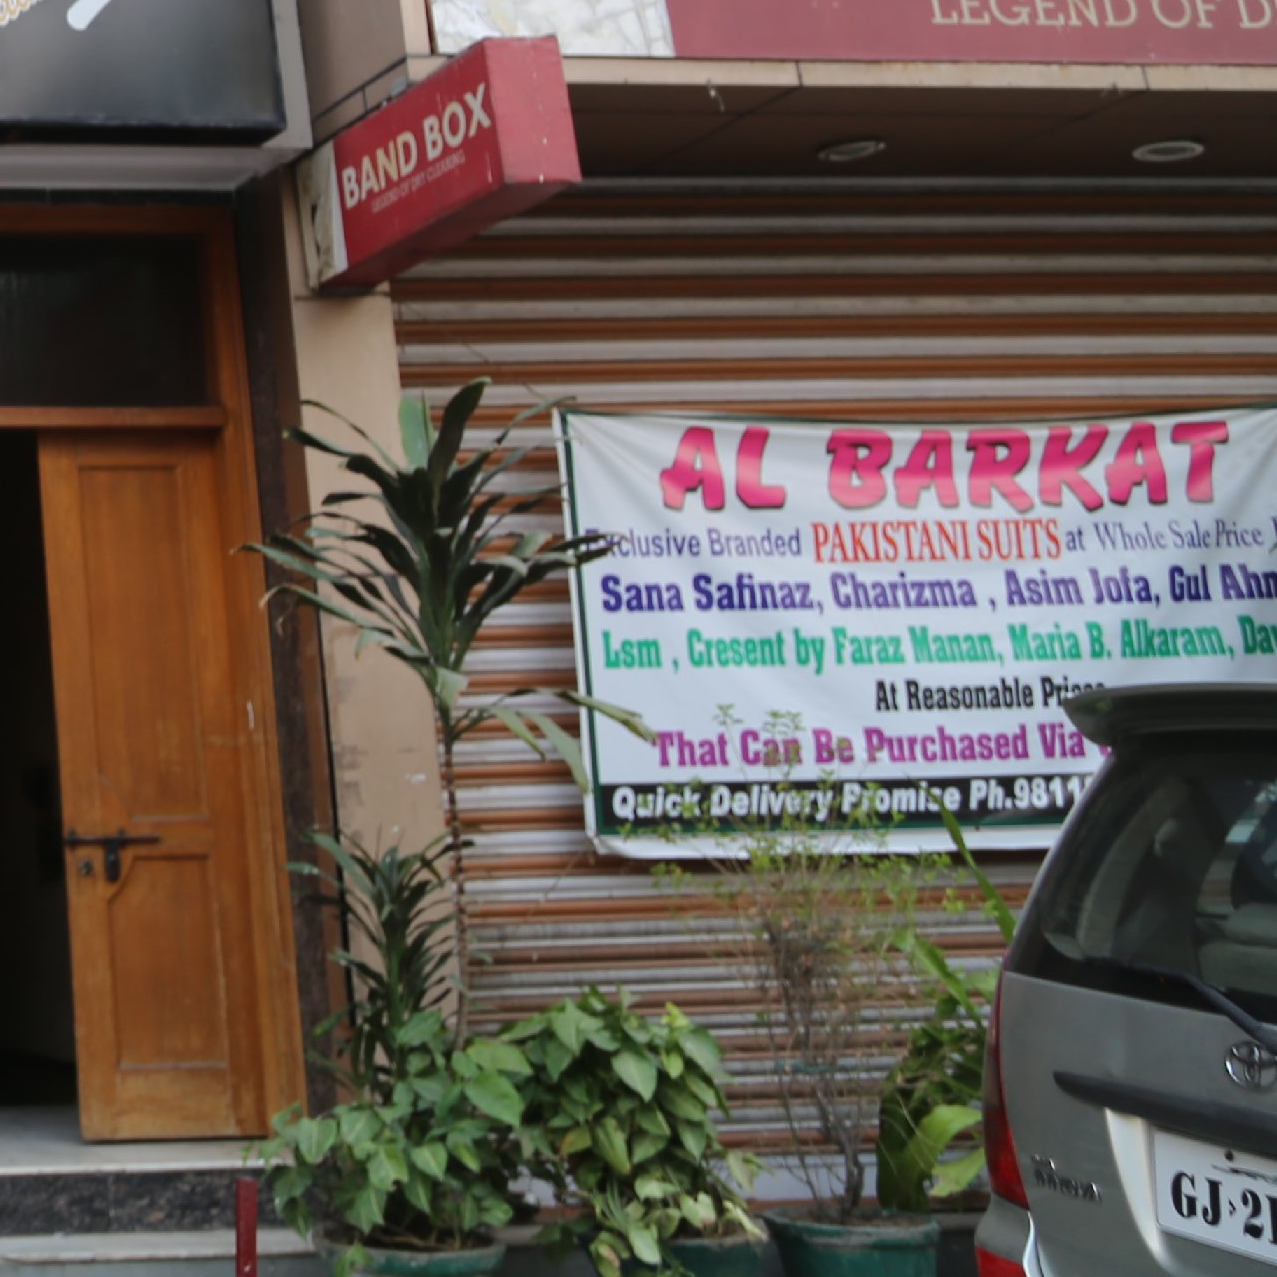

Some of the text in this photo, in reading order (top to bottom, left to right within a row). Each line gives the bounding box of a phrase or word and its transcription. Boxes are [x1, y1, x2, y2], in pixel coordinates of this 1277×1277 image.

[342, 81, 492, 210] BAND BOX
[659, 420, 1228, 513] AL BARKAT
[707, 527, 802, 557] Branded
[812, 520, 971, 564] PAKISTANI
[977, 518, 1061, 562] SUITS
[1066, 527, 1085, 552] at
[1094, 523, 1166, 552] Whole
[1168, 521, 1211, 549] Sale
[1214, 519, 1264, 550] Price
[601, 574, 684, 612] Sana
[693, 573, 824, 616] Safinaz,
[830, 570, 977, 611] Charizma
[1005, 567, 1084, 606] Asim
[1169, 564, 1212, 602] Gul
[602, 628, 662, 669] Lsm
[686, 628, 785, 667] Cresent
[794, 627, 825, 675] by
[831, 627, 905, 665] Faraz
[908, 626, 1004, 667] Manan,
[1007, 622, 1082, 661] Maria
[1085, 621, 1112, 660] B.
[875, 679, 899, 712] At
[904, 676, 1035, 711] Reasonable
[655, 722, 1086, 767] That Can Be Purchased Via
[612, 784, 703, 822] Quick
[710, 782, 834, 822] Delivery
[840, 780, 962, 815] Promise
